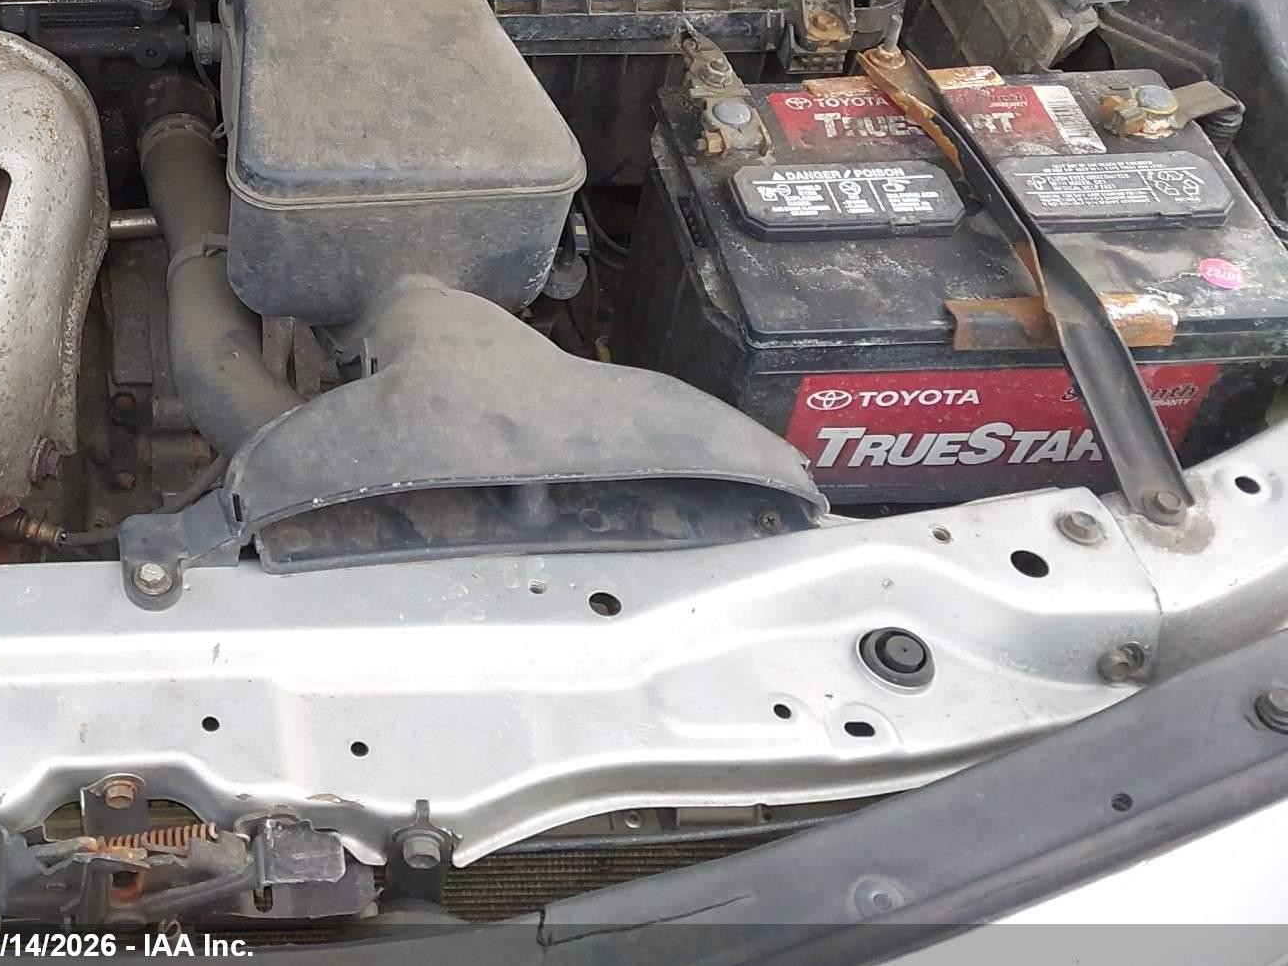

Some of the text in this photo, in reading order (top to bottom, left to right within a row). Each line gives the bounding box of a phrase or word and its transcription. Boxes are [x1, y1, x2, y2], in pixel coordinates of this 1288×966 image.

[813, 96, 890, 108] TOYOTA
[785, 170, 842, 181] DANGER
[853, 168, 906, 178] POISON
[859, 389, 980, 407] TOYOTA
